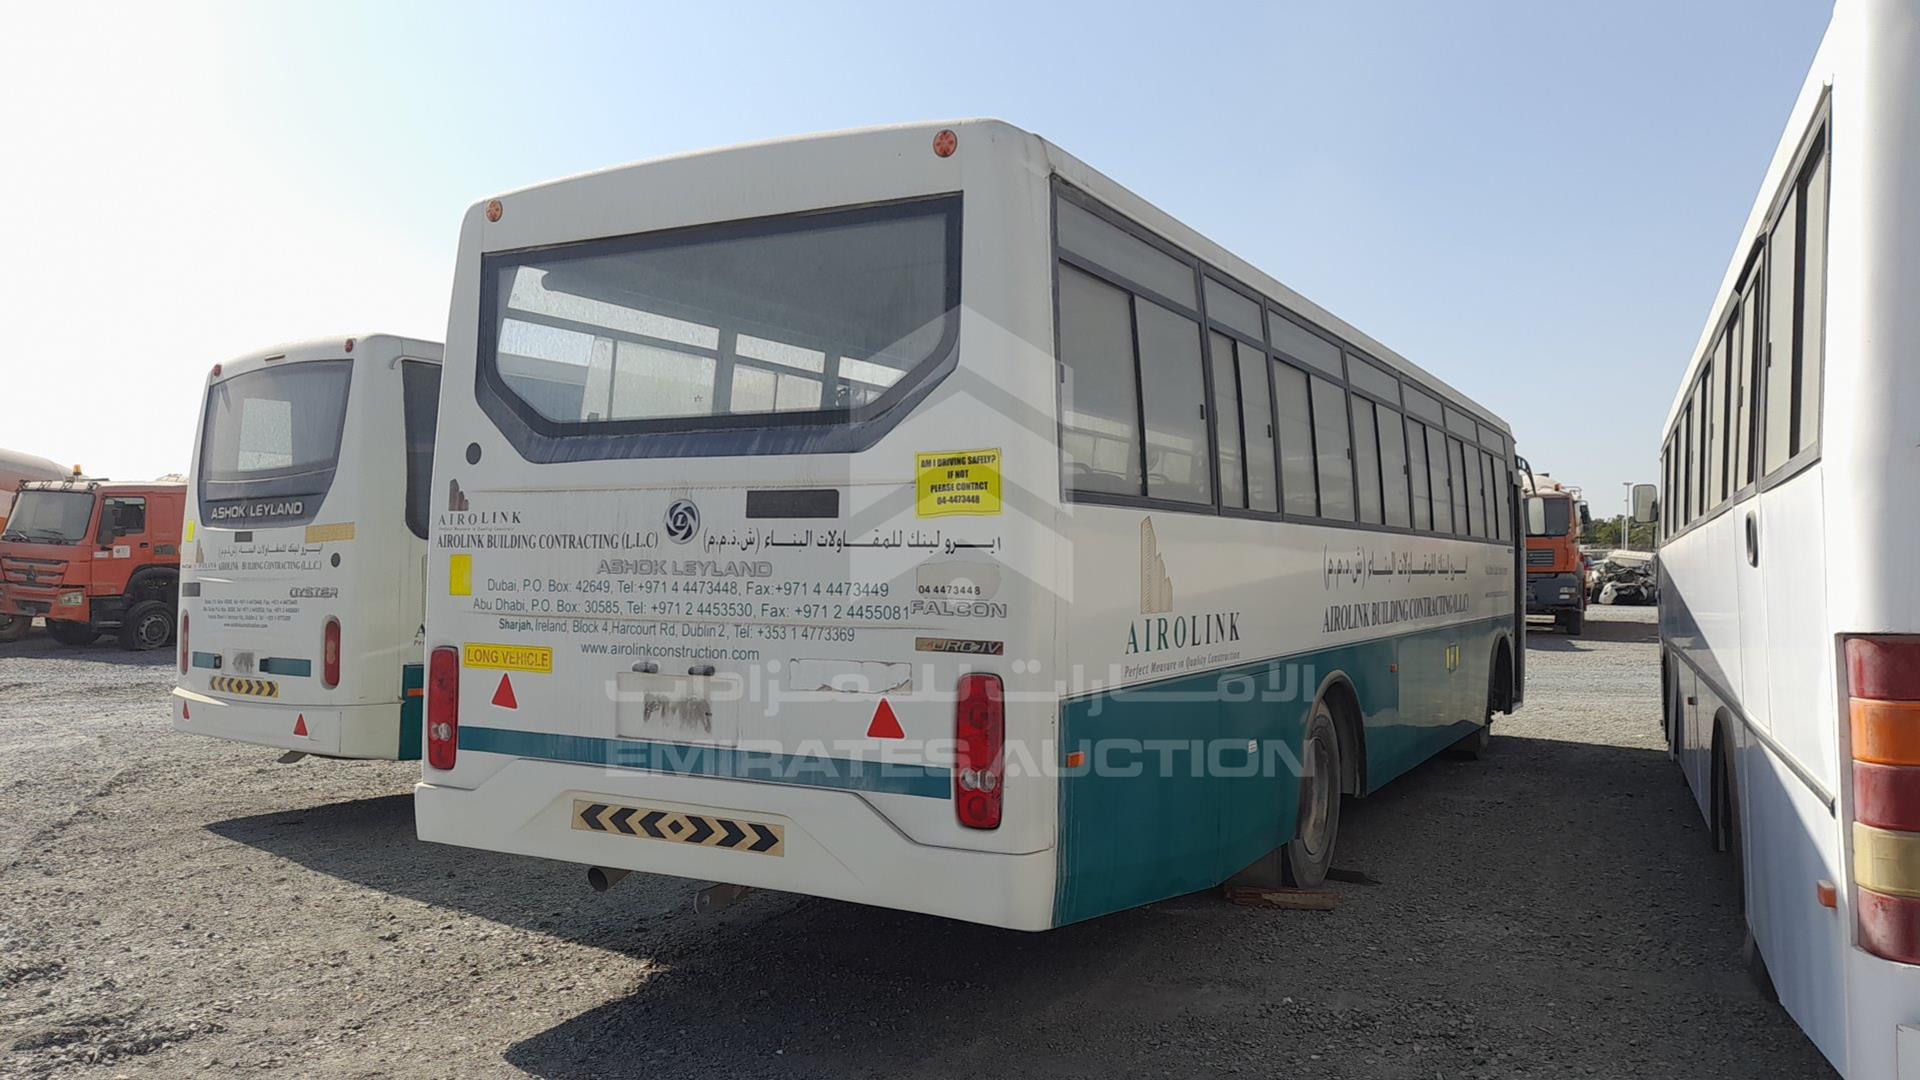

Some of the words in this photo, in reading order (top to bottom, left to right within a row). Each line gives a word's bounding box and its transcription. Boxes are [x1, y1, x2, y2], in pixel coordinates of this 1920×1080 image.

[921, 459, 931, 468] AM
[937, 456, 966, 467] DRIVING
[967, 454, 996, 465] SAFELY?
[947, 470, 954, 479] IF
[955, 469, 969, 479] NOT
[930, 482, 955, 493] PLEASE
[956, 481, 988, 492] CONTACT
[211, 505, 247, 520] ASHOK
[250, 501, 303, 518] LEYLAND
[438, 511, 522, 526] AIROLINK
[437, 534, 485, 549] AIROLINK
[487, 533, 536, 549] BUILDING
[538, 533, 619, 550] CONTRACTING
[621, 531, 658, 550] (L.L.C)
[597, 558, 668, 576] ASHOK
[672, 560, 773, 578] LEYLAND
[289, 586, 339, 599] OYSTER
[488, 578, 519, 593] Dubai,
[523, 579, 545, 592] P.O.
[548, 579, 573, 593] Box:
[575, 580, 613, 595] 42649,
[671, 581, 679, 593] 4
[683, 581, 742, 597] 4473448,
[813, 583, 821, 595] 4
[825, 582, 889, 597] 4473449
[919, 585, 930, 594] 04
[473, 598, 493, 611] Abu
[495, 598, 528, 613] Dhabi,
[531, 599, 552, 612] P.O.
[557, 600, 580, 613] Box:
[584, 600, 623, 616] 30585,
[627, 600, 647, 614] Tel:
[651, 601, 680, 615] +971
[685, 602, 693, 615] 2
[697, 602, 757, 619] 4453530,
[761, 603, 789, 618] Fax:
[795, 604, 828, 619] +971
[834, 605, 842, 619] 2
[846, 605, 909, 621] 4455081
[910, 600, 1007, 619] FALCON
[1322, 603, 1370, 633] AIROLINK
[1372, 599, 1409, 627] BUILDING
[1409, 594, 1453, 620] CONTRACTING
[499, 618, 534, 633] Sharjah,
[573, 620, 600, 633] Block
[660, 623, 678, 637] Rd,
[682, 624, 716, 638] Dublin
[733, 625, 752, 639] Tel:
[757, 625, 786, 640] +353
[791, 627, 797, 640] 1
[801, 627, 855, 642] 4773369
[1125, 612, 1241, 655] AIROLINK
[467, 647, 499, 665] LONG
[502, 651, 549, 668] VEHICLE
[581, 641, 760, 661] www.airolinkconstruction.com
[1124, 662, 1150, 682] Perfect
[1151, 659, 1177, 674] Measure
[1178, 658, 1184, 669] in
[1186, 655, 1206, 673] Quality
[1207, 650, 1241, 666] Construction
